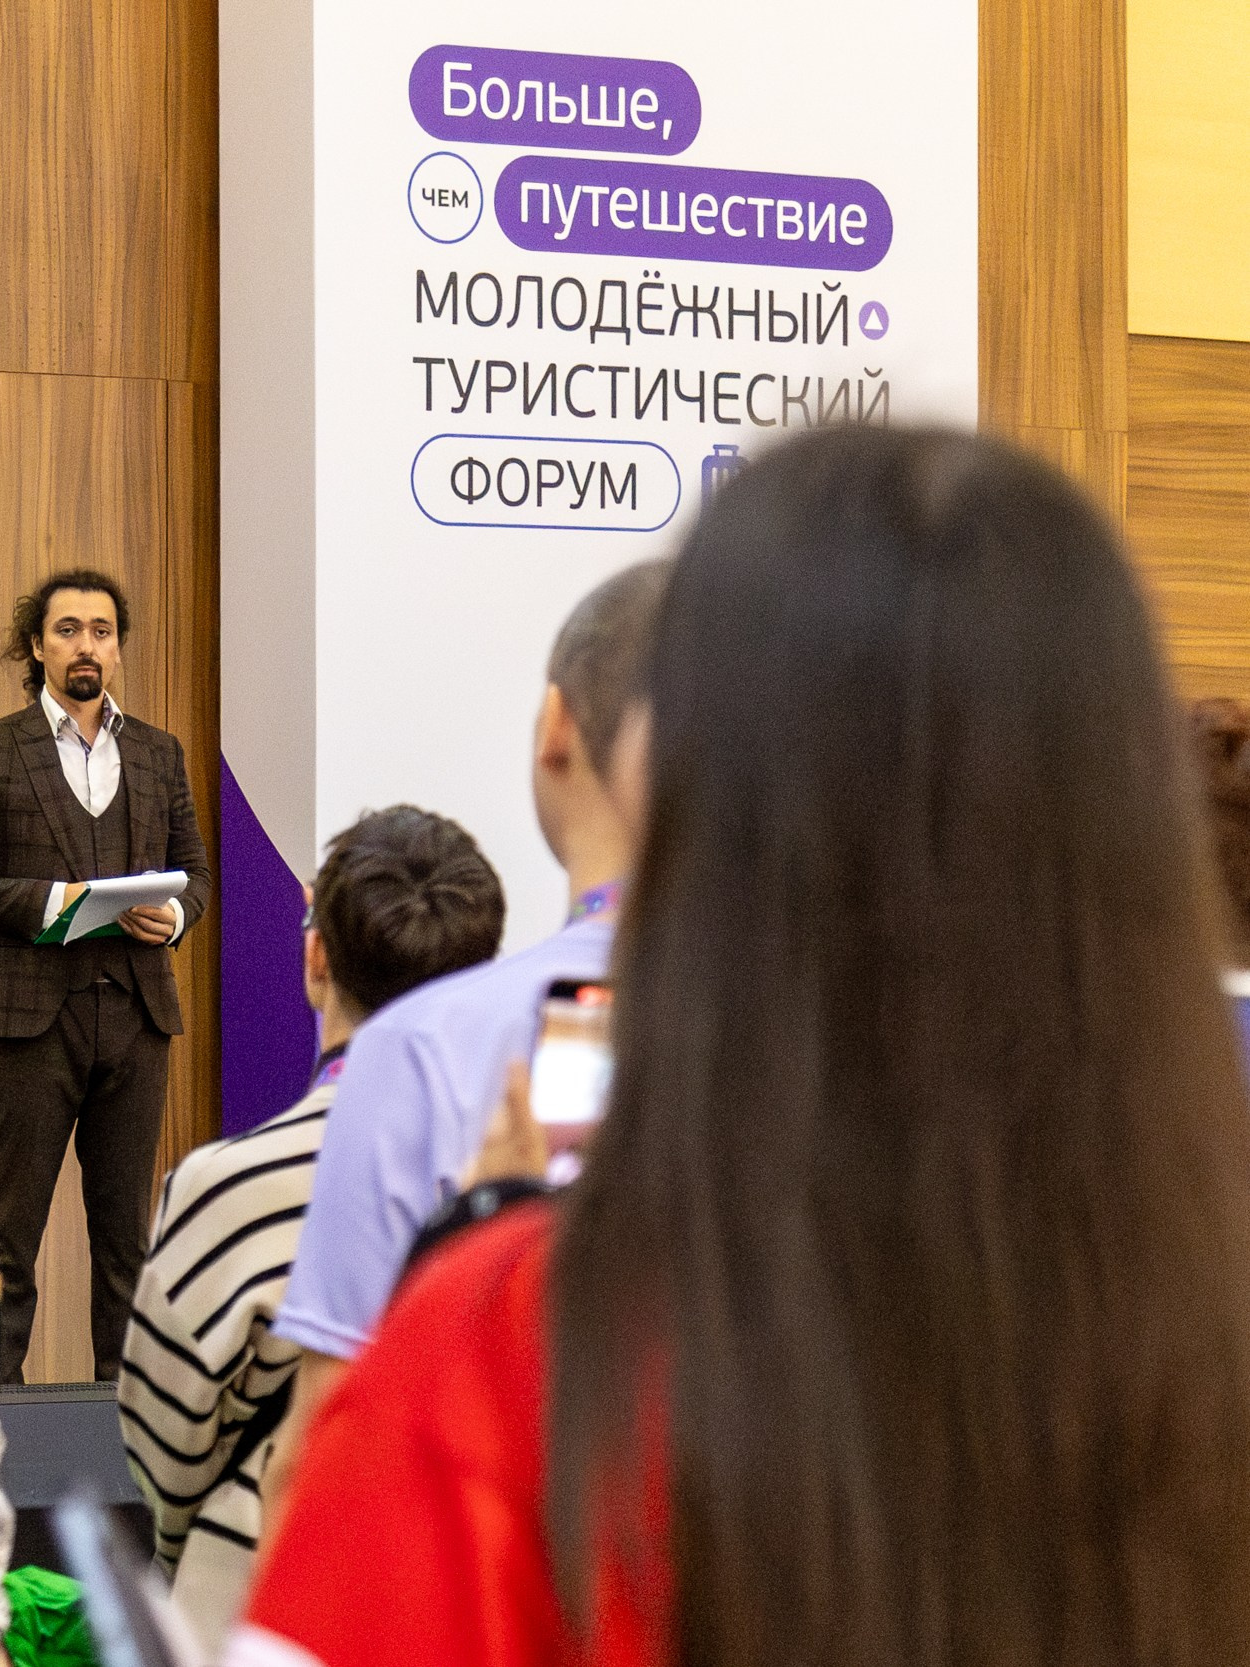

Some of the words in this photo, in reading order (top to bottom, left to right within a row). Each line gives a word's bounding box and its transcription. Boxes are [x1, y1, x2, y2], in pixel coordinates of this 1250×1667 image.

[442, 61, 673, 141] Больше,
[421, 187, 470, 209] ЧЕМ
[519, 181, 868, 246] путешествие
[415, 268, 850, 347] МОЛОДЁЖНЫЙ
[412, 356, 891, 429] ТУРИСТИЧЕСКИЙ
[449, 456, 639, 511] ФОРУМ
